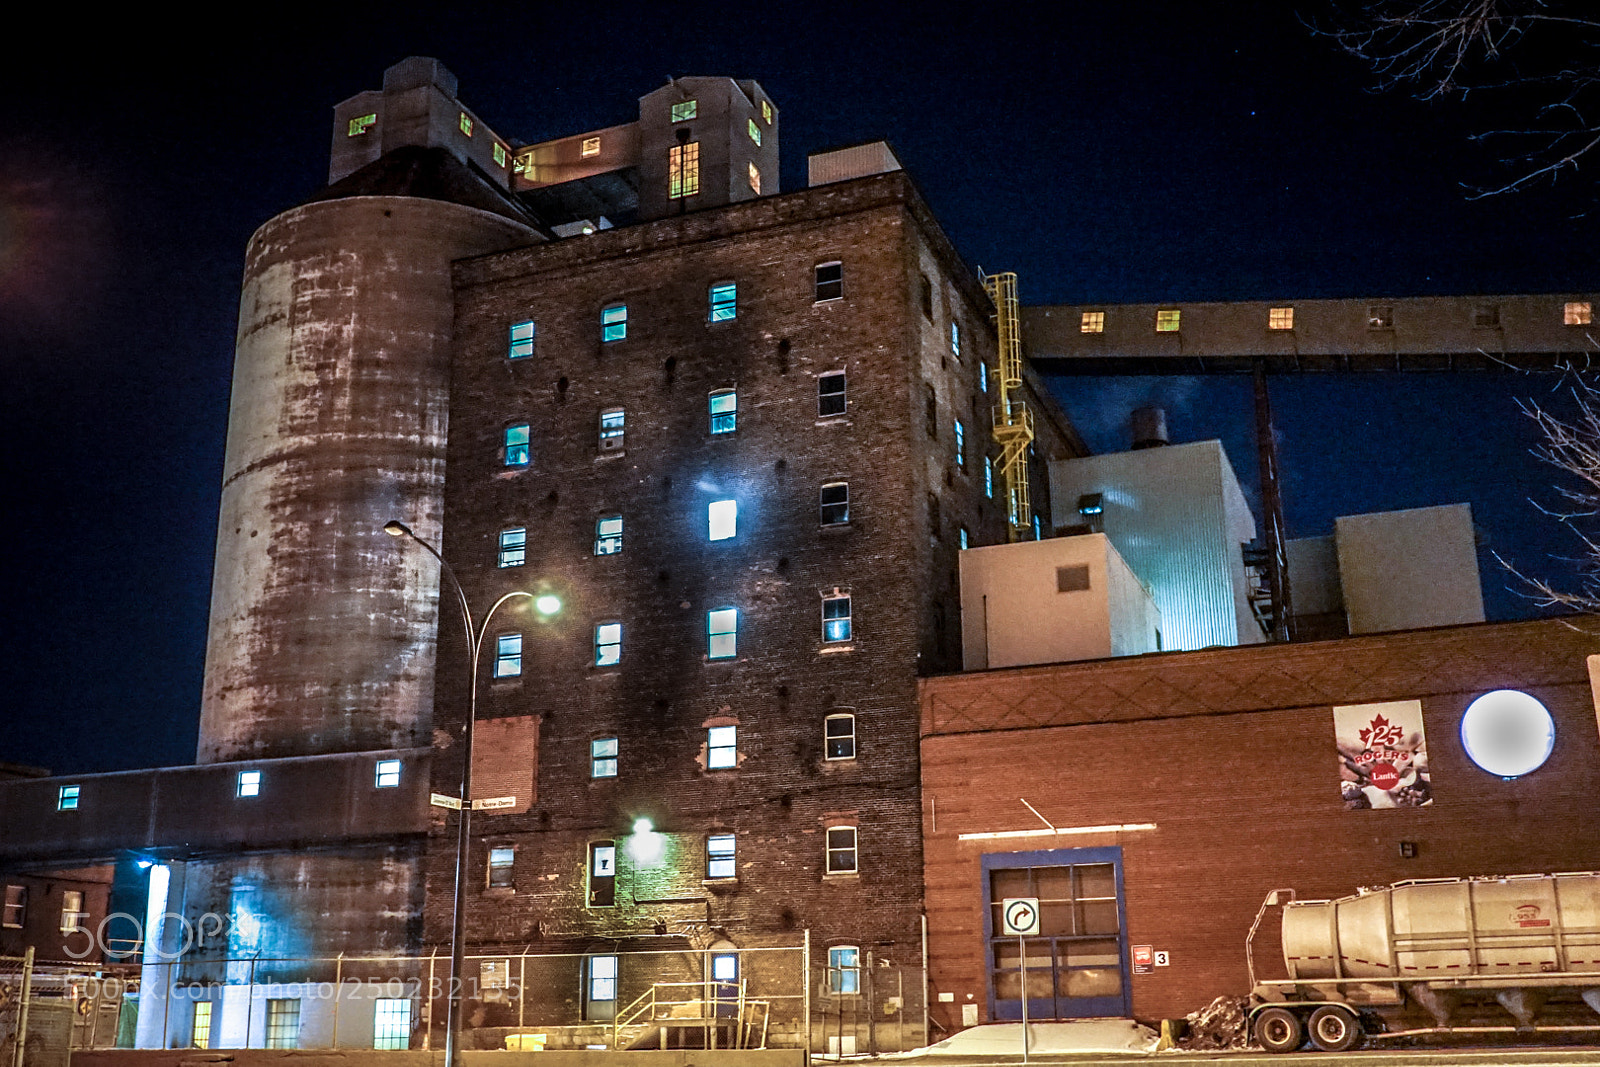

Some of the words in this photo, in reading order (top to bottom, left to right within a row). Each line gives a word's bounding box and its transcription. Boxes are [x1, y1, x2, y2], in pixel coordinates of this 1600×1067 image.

[1365, 725, 1401, 749] 125
[1355, 750, 1409, 764] ROGERS
[1372, 772, 1397, 780] Lantic
[1158, 953, 1166, 965] 3
